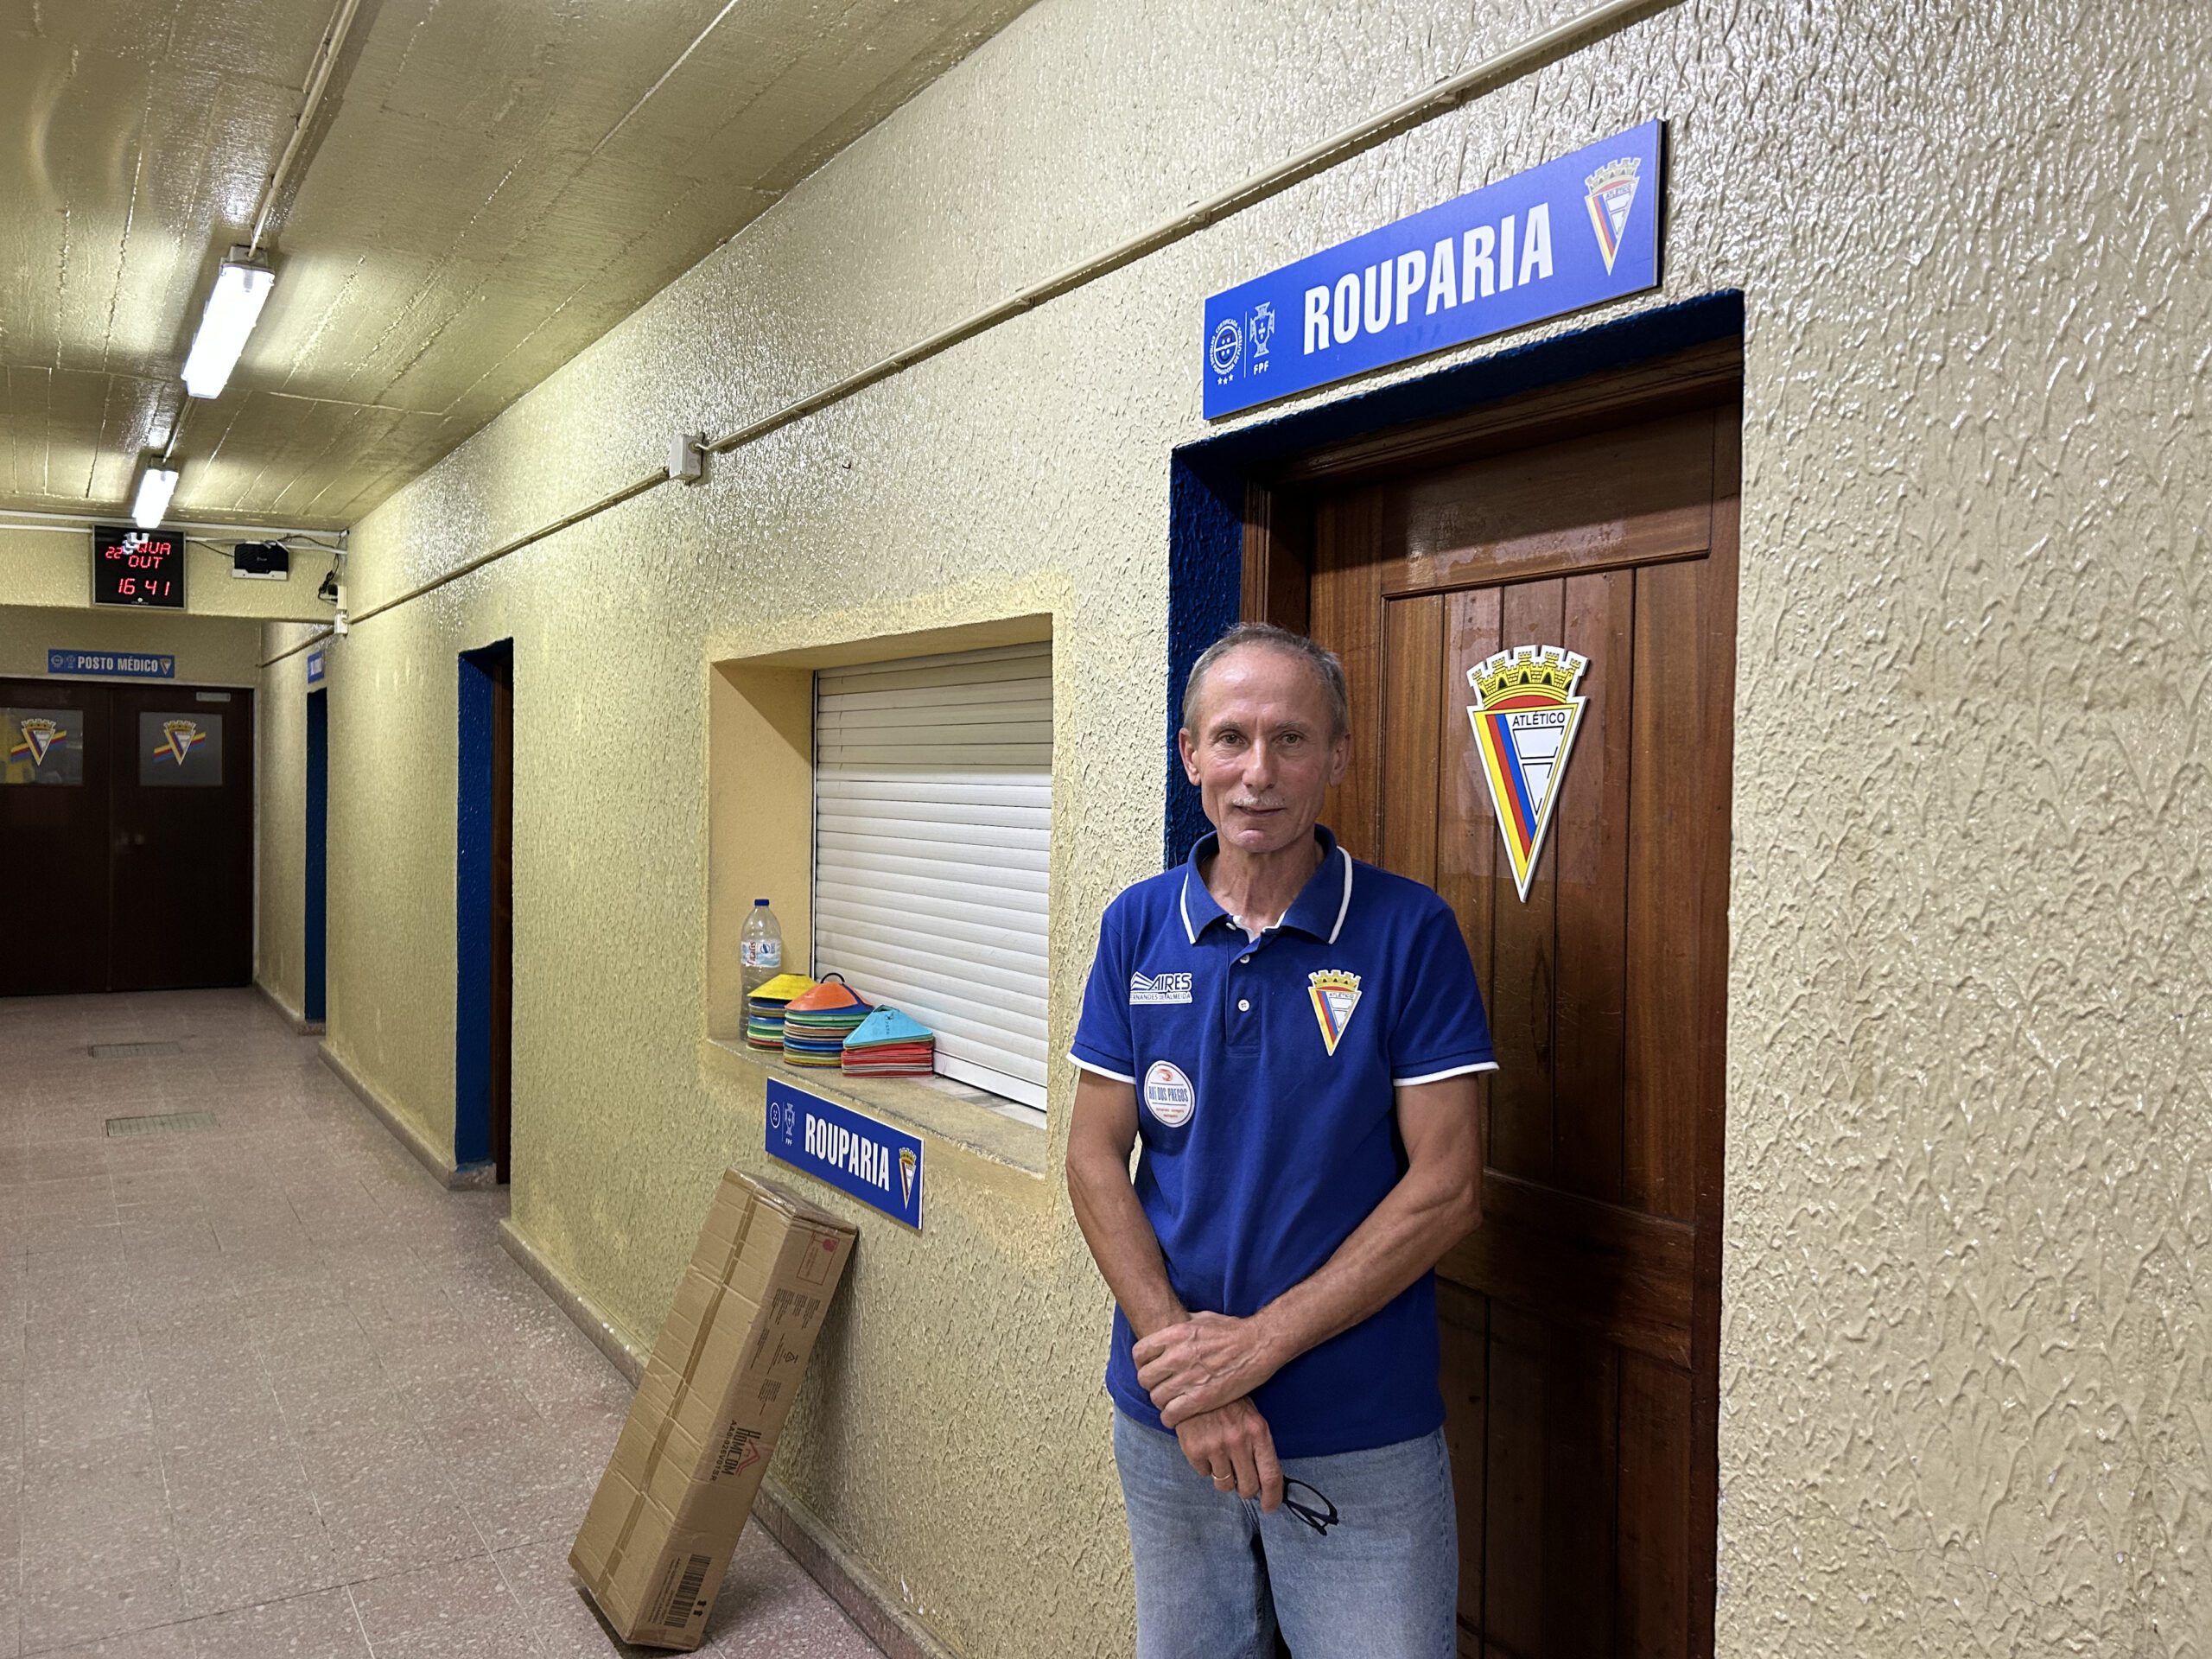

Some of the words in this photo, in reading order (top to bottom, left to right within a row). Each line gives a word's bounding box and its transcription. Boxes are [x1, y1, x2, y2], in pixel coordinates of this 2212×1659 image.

[1303, 201, 1554, 356] ROUPARIA
[1253, 360, 1269, 376] FPF
[137, 542, 171, 555] QUA
[128, 555, 163, 569] OUT
[78, 656, 113, 670] POSTO
[118, 656, 158, 672] MÉDICO
[1512, 711, 1566, 727] ATLÉTICO
[1147, 974, 1191, 990] AIRES
[804, 1113, 890, 1192] ROUPARIA
